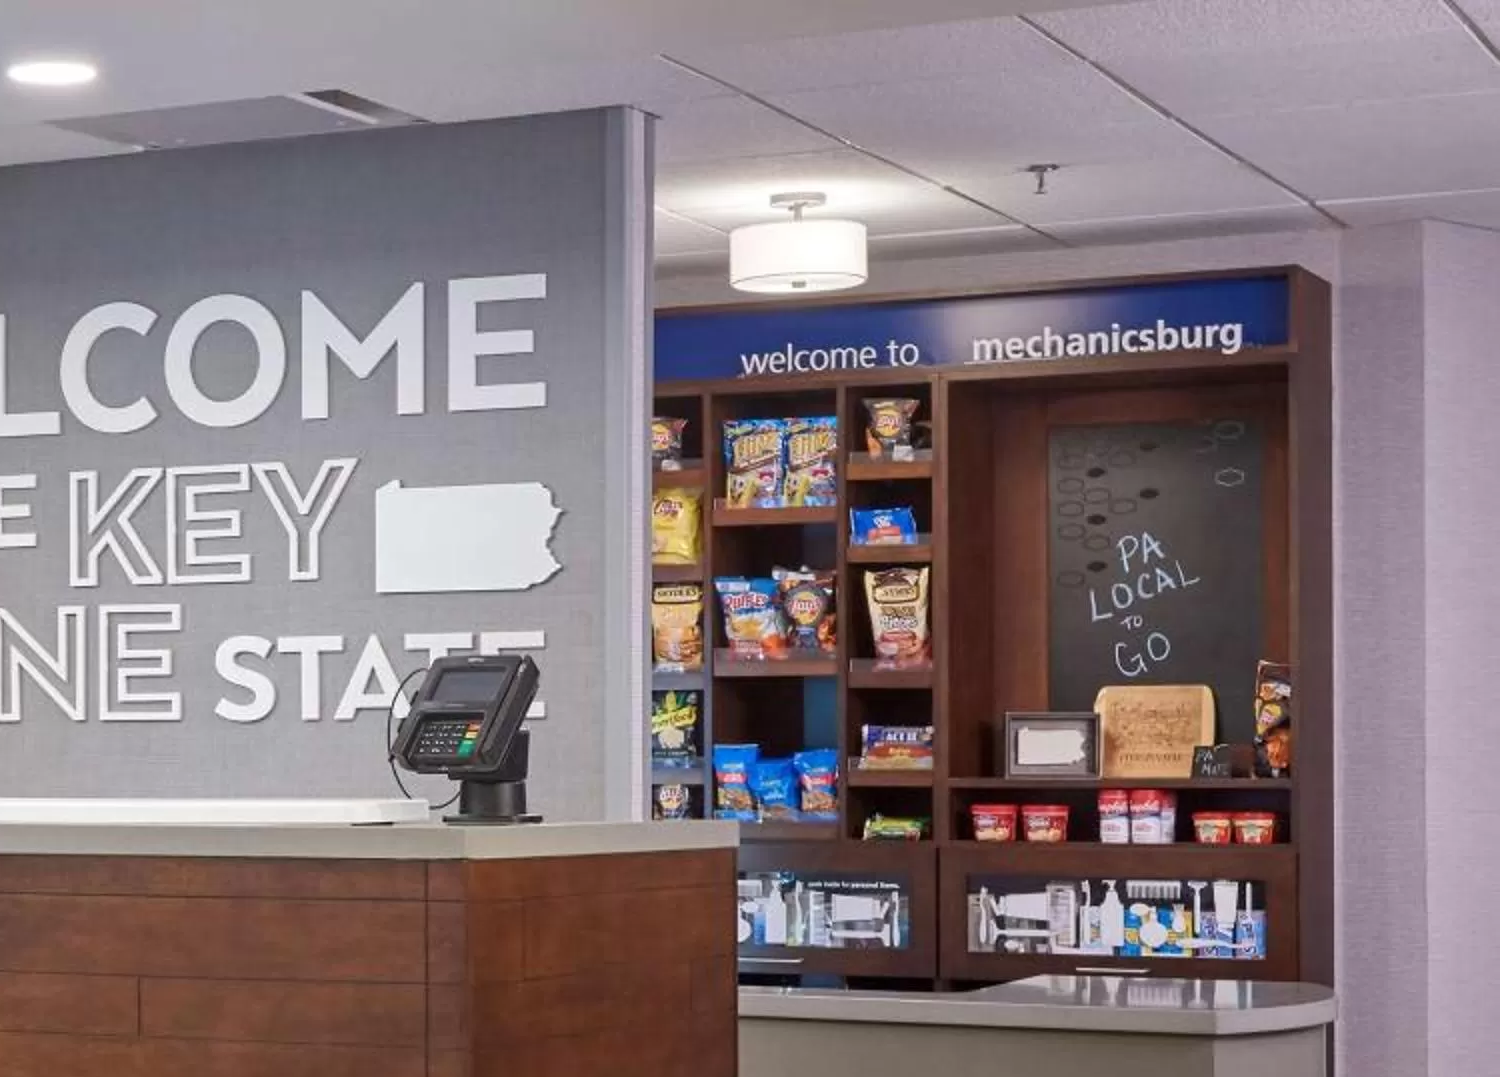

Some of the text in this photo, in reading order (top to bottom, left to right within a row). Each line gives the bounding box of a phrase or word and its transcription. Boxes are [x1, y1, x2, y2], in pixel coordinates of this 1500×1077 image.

[740, 319, 1244, 376] welcome to mechanicsburg
[68, 457, 360, 588] KEY
[1116, 531, 1166, 573] PA
[1088, 560, 1201, 622] LOCAL
[1120, 615, 1143, 630] TO
[1114, 632, 1171, 677] GO
